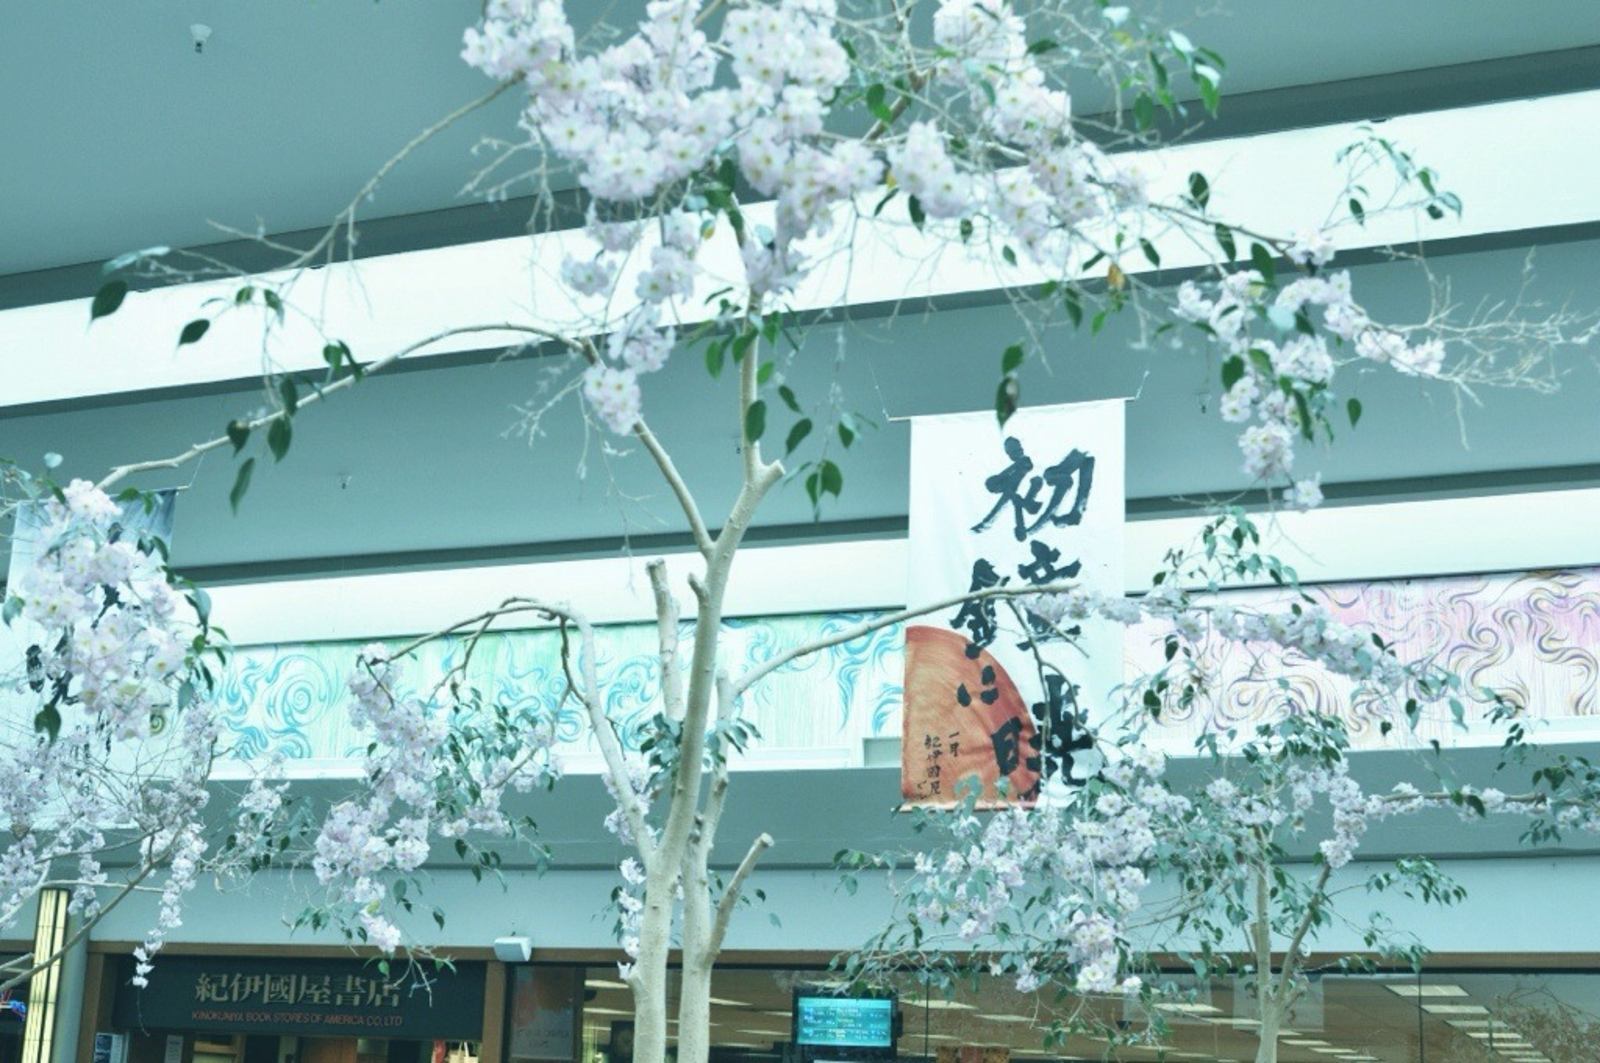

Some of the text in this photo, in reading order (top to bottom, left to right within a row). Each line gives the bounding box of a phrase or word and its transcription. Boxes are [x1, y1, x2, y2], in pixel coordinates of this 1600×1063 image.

[194, 972, 401, 1007] 紀伊國屋書店
[246, 1011, 272, 1022] BOOK
[273, 1012, 309, 1023] STORES
[310, 1013, 321, 1023] OF
[324, 1014, 364, 1025] AMERICA
